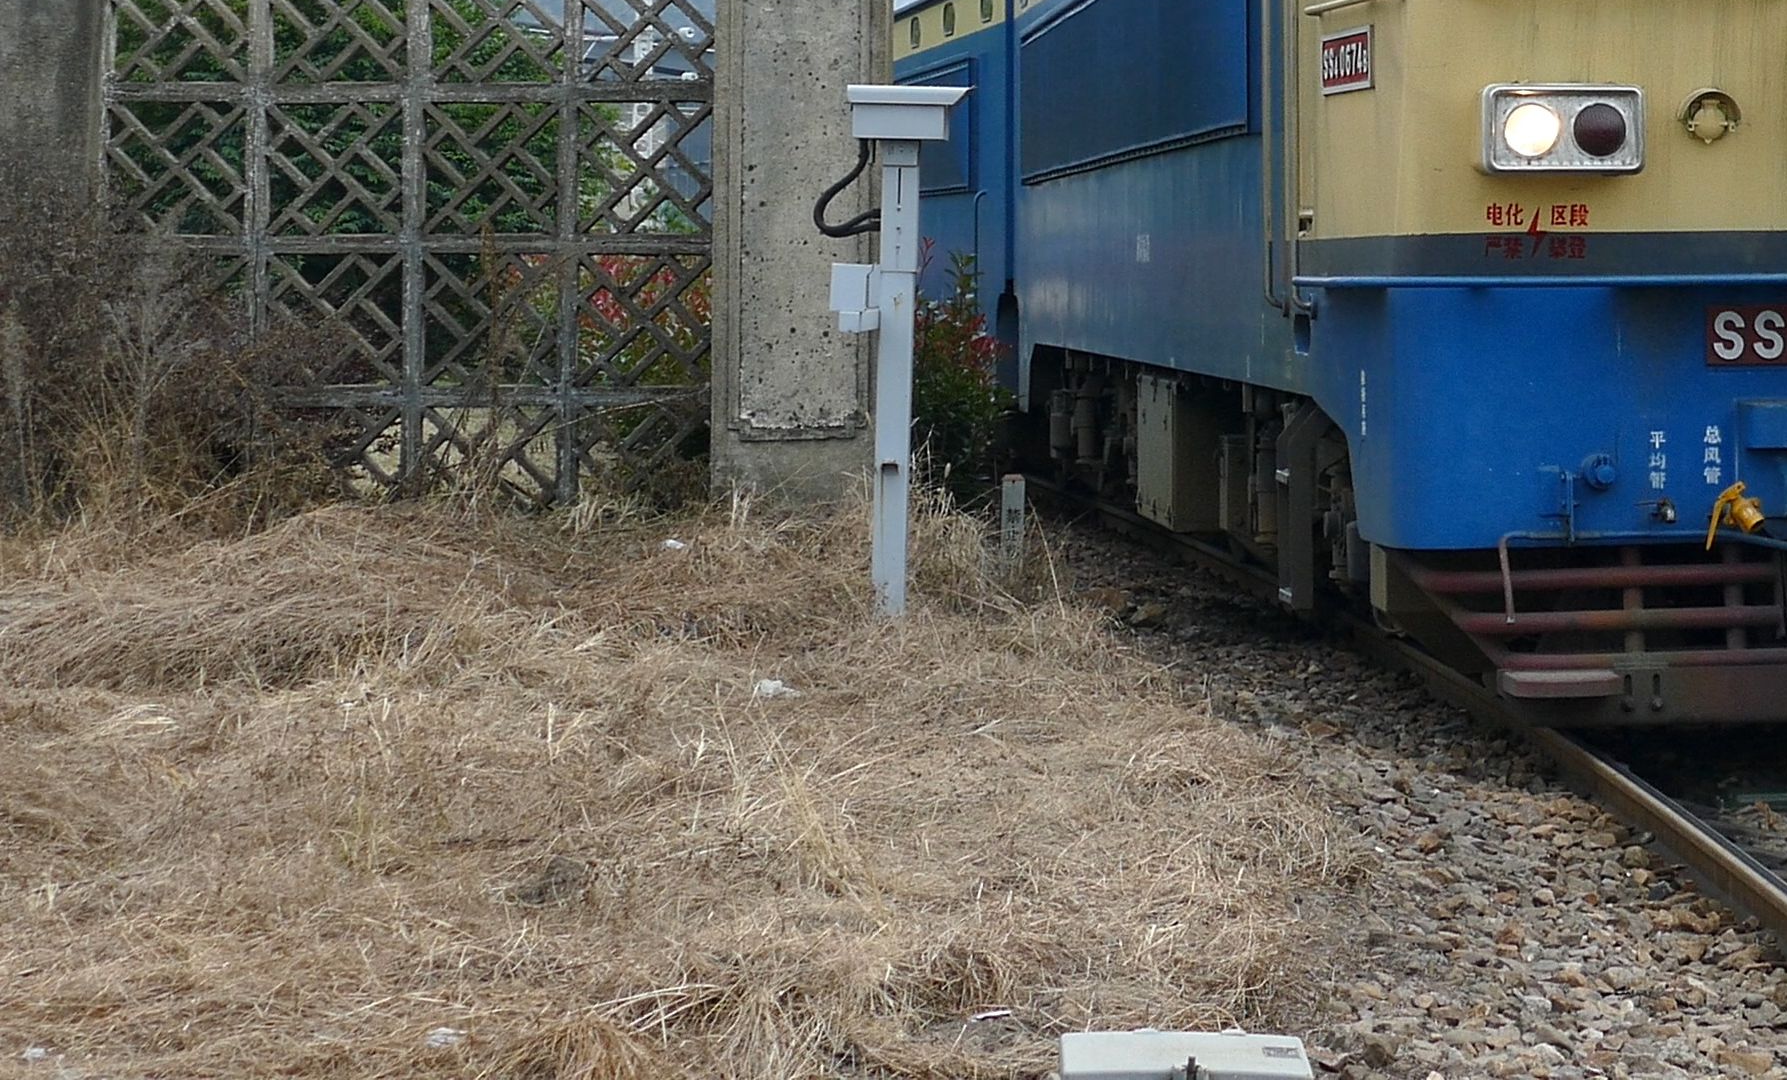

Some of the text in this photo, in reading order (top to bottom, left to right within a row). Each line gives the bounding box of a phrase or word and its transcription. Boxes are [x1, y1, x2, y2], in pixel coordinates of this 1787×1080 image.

[1486, 202, 1589, 226] 电化 区段
[1648, 430, 1667, 490] 平均管
